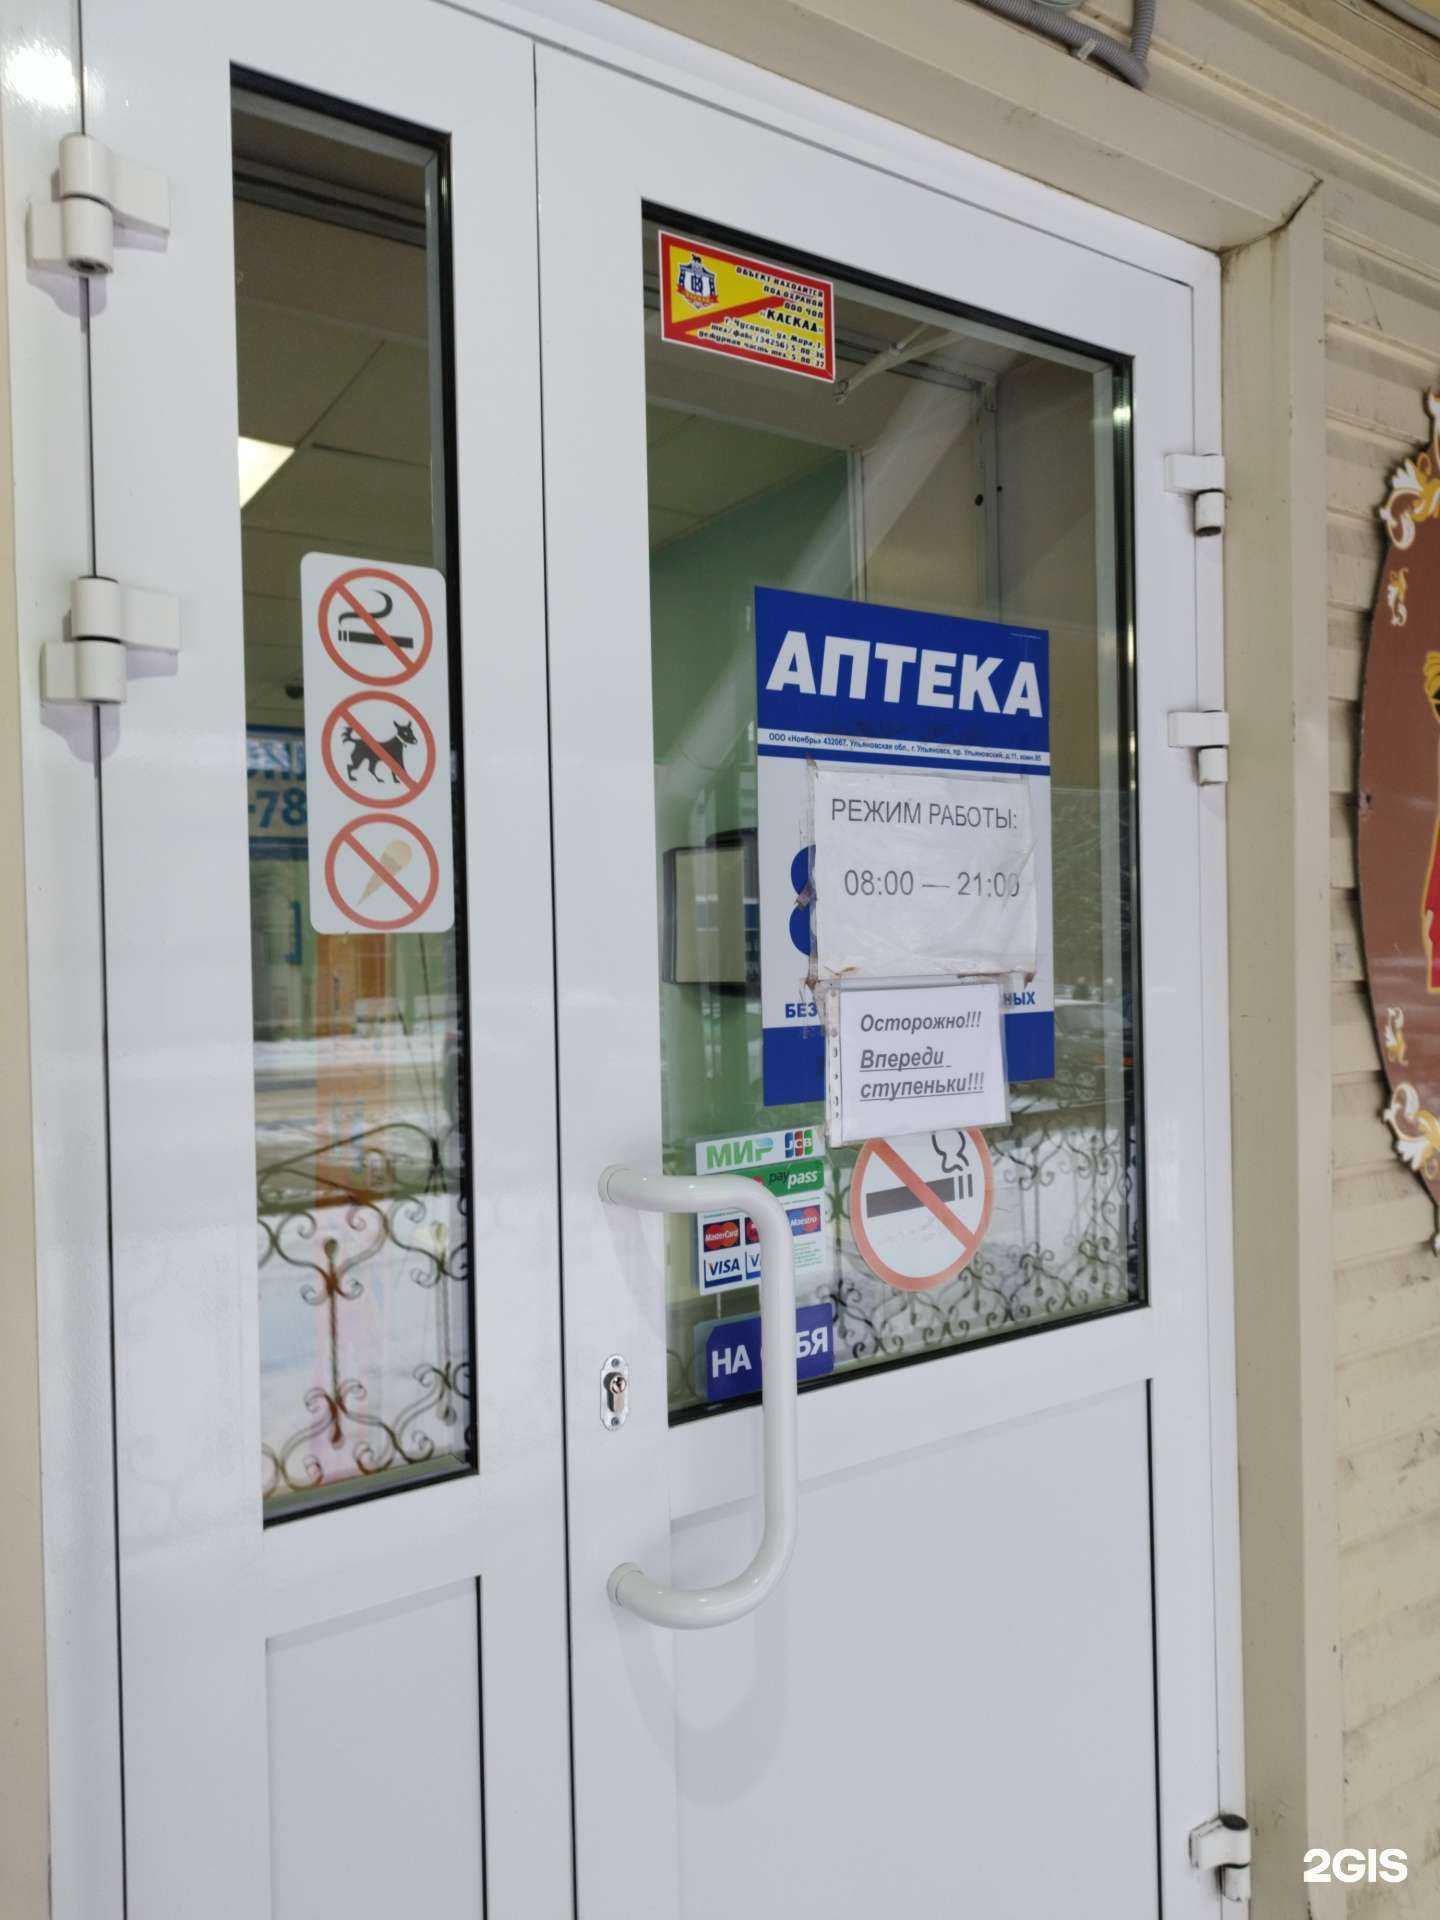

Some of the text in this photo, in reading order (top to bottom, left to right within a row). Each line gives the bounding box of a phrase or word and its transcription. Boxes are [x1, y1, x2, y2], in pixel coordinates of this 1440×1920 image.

[736, 266, 824, 297] ОБЪЕКТ НАХОДИТСЯ
[763, 285, 824, 308] ПОД ОХРАНОЙ
[784, 302, 824, 319] ООО ЧОП
[765, 630, 1043, 718] АПТЕКА
[768, 732, 786, 742] ООО
[787, 734, 822, 746] «Ноябрь»
[831, 798, 1017, 829] РЕЖИМ РАБОТЫ:
[844, 868, 914, 896] 08:00
[957, 871, 1020, 897] 21:00
[785, 1002, 818, 1019] БЕЗ
[860, 1010, 981, 1035] Осторожно!!!
[860, 1046, 945, 1073] Впереди
[860, 1071, 985, 1101] ступеньки!!!
[706, 1136, 774, 1170] МИР
[789, 1214, 818, 1227] Maestro
[705, 1229, 740, 1242] MasterCard
[709, 1258, 740, 1276] VISA
[711, 1344, 752, 1378] НА
